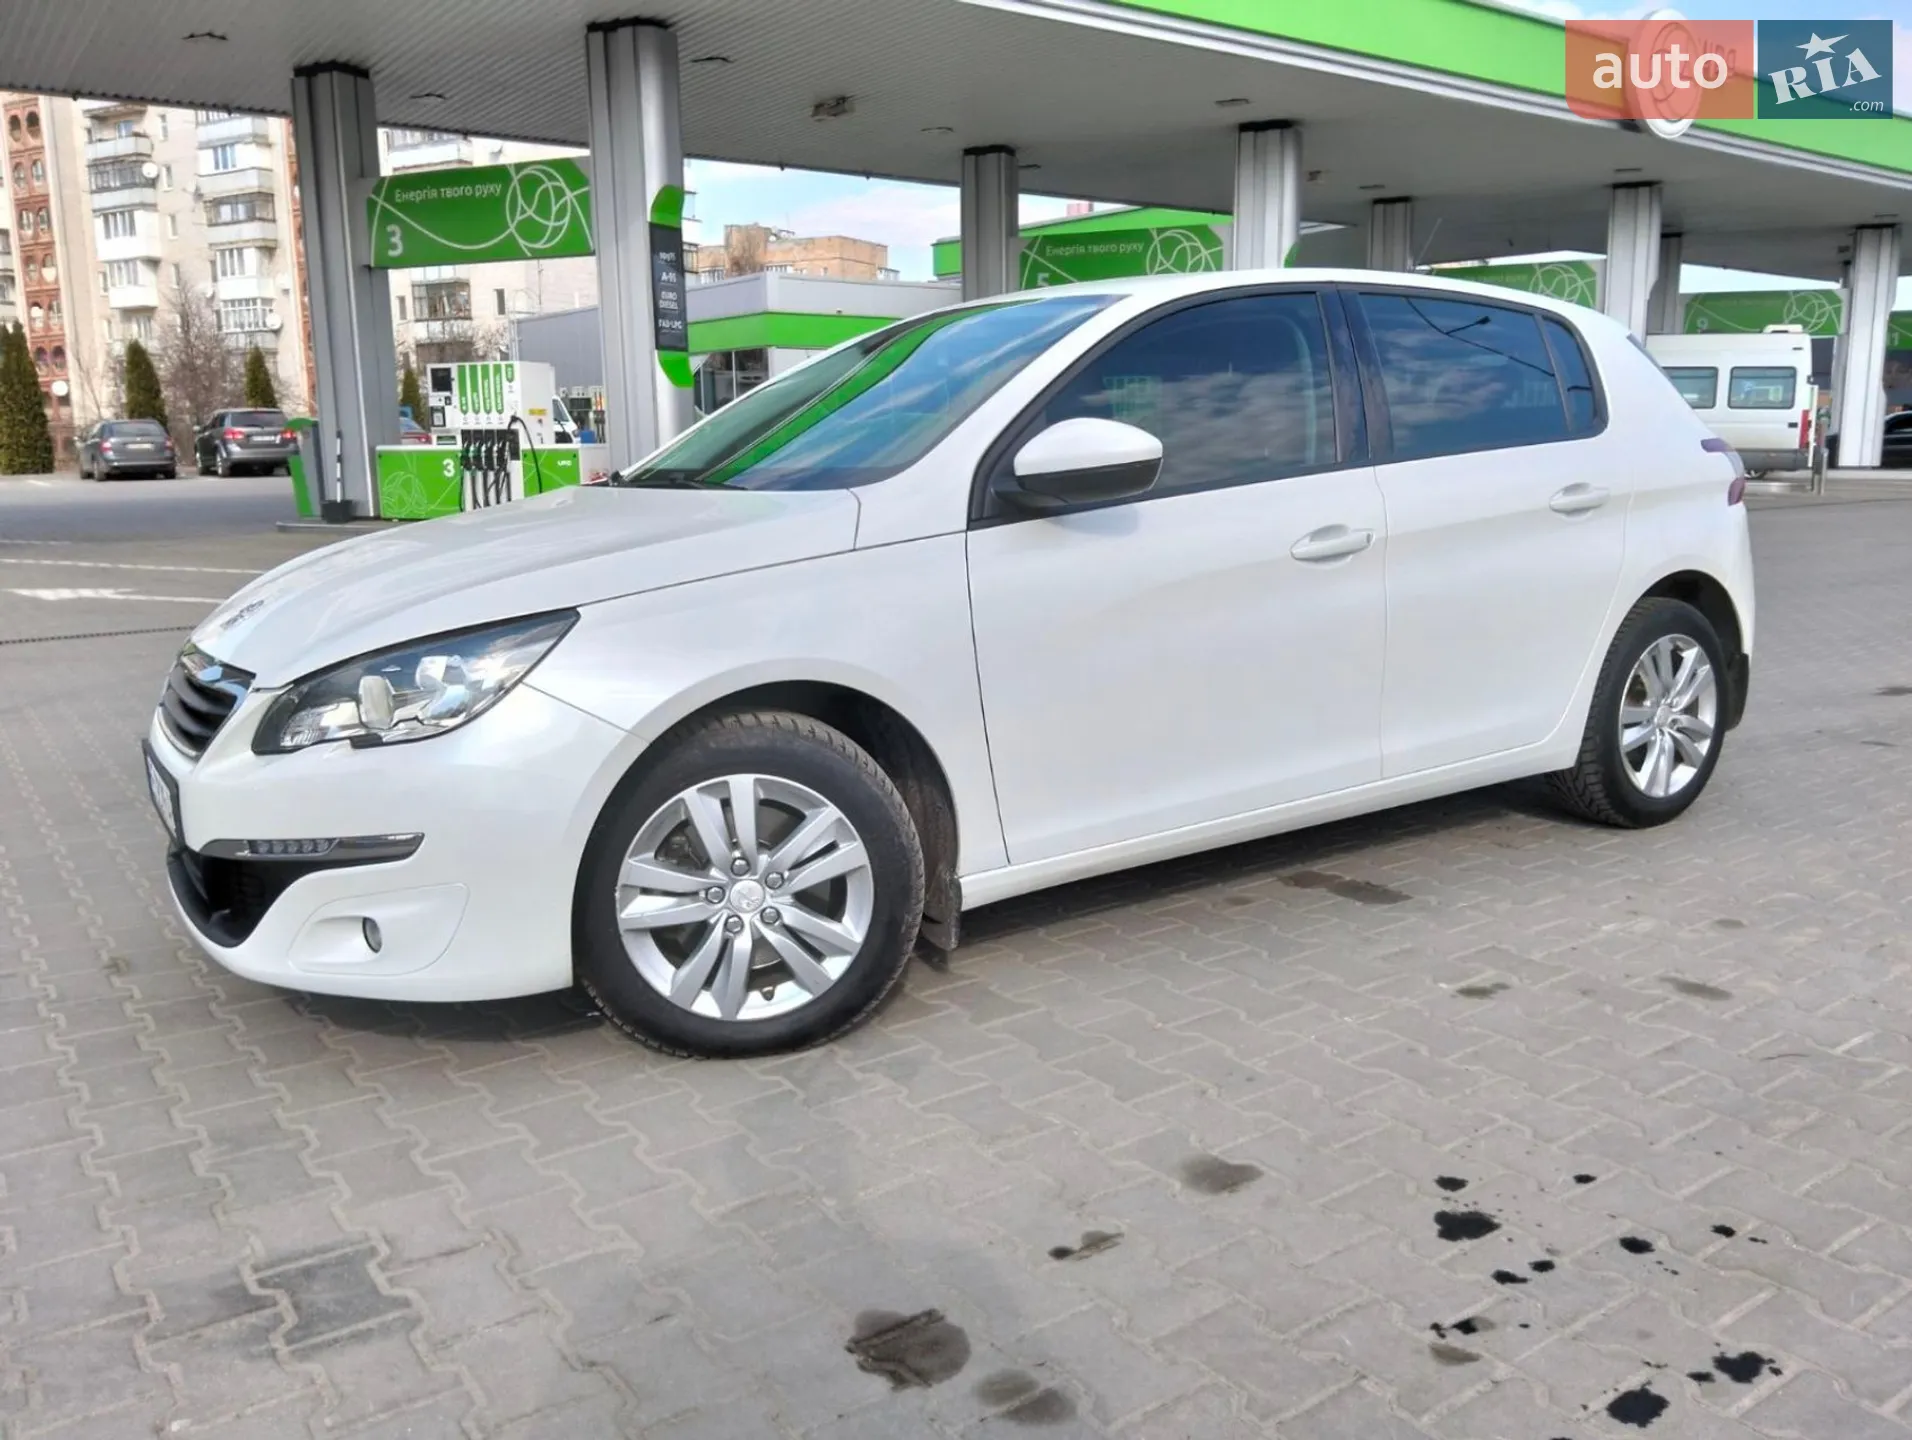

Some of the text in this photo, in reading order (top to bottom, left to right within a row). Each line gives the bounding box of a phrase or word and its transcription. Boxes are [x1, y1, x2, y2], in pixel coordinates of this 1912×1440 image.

[395, 182, 502, 203] Енергія твого руху
[386, 224, 404, 257] 3
[442, 458, 455, 477] 3
